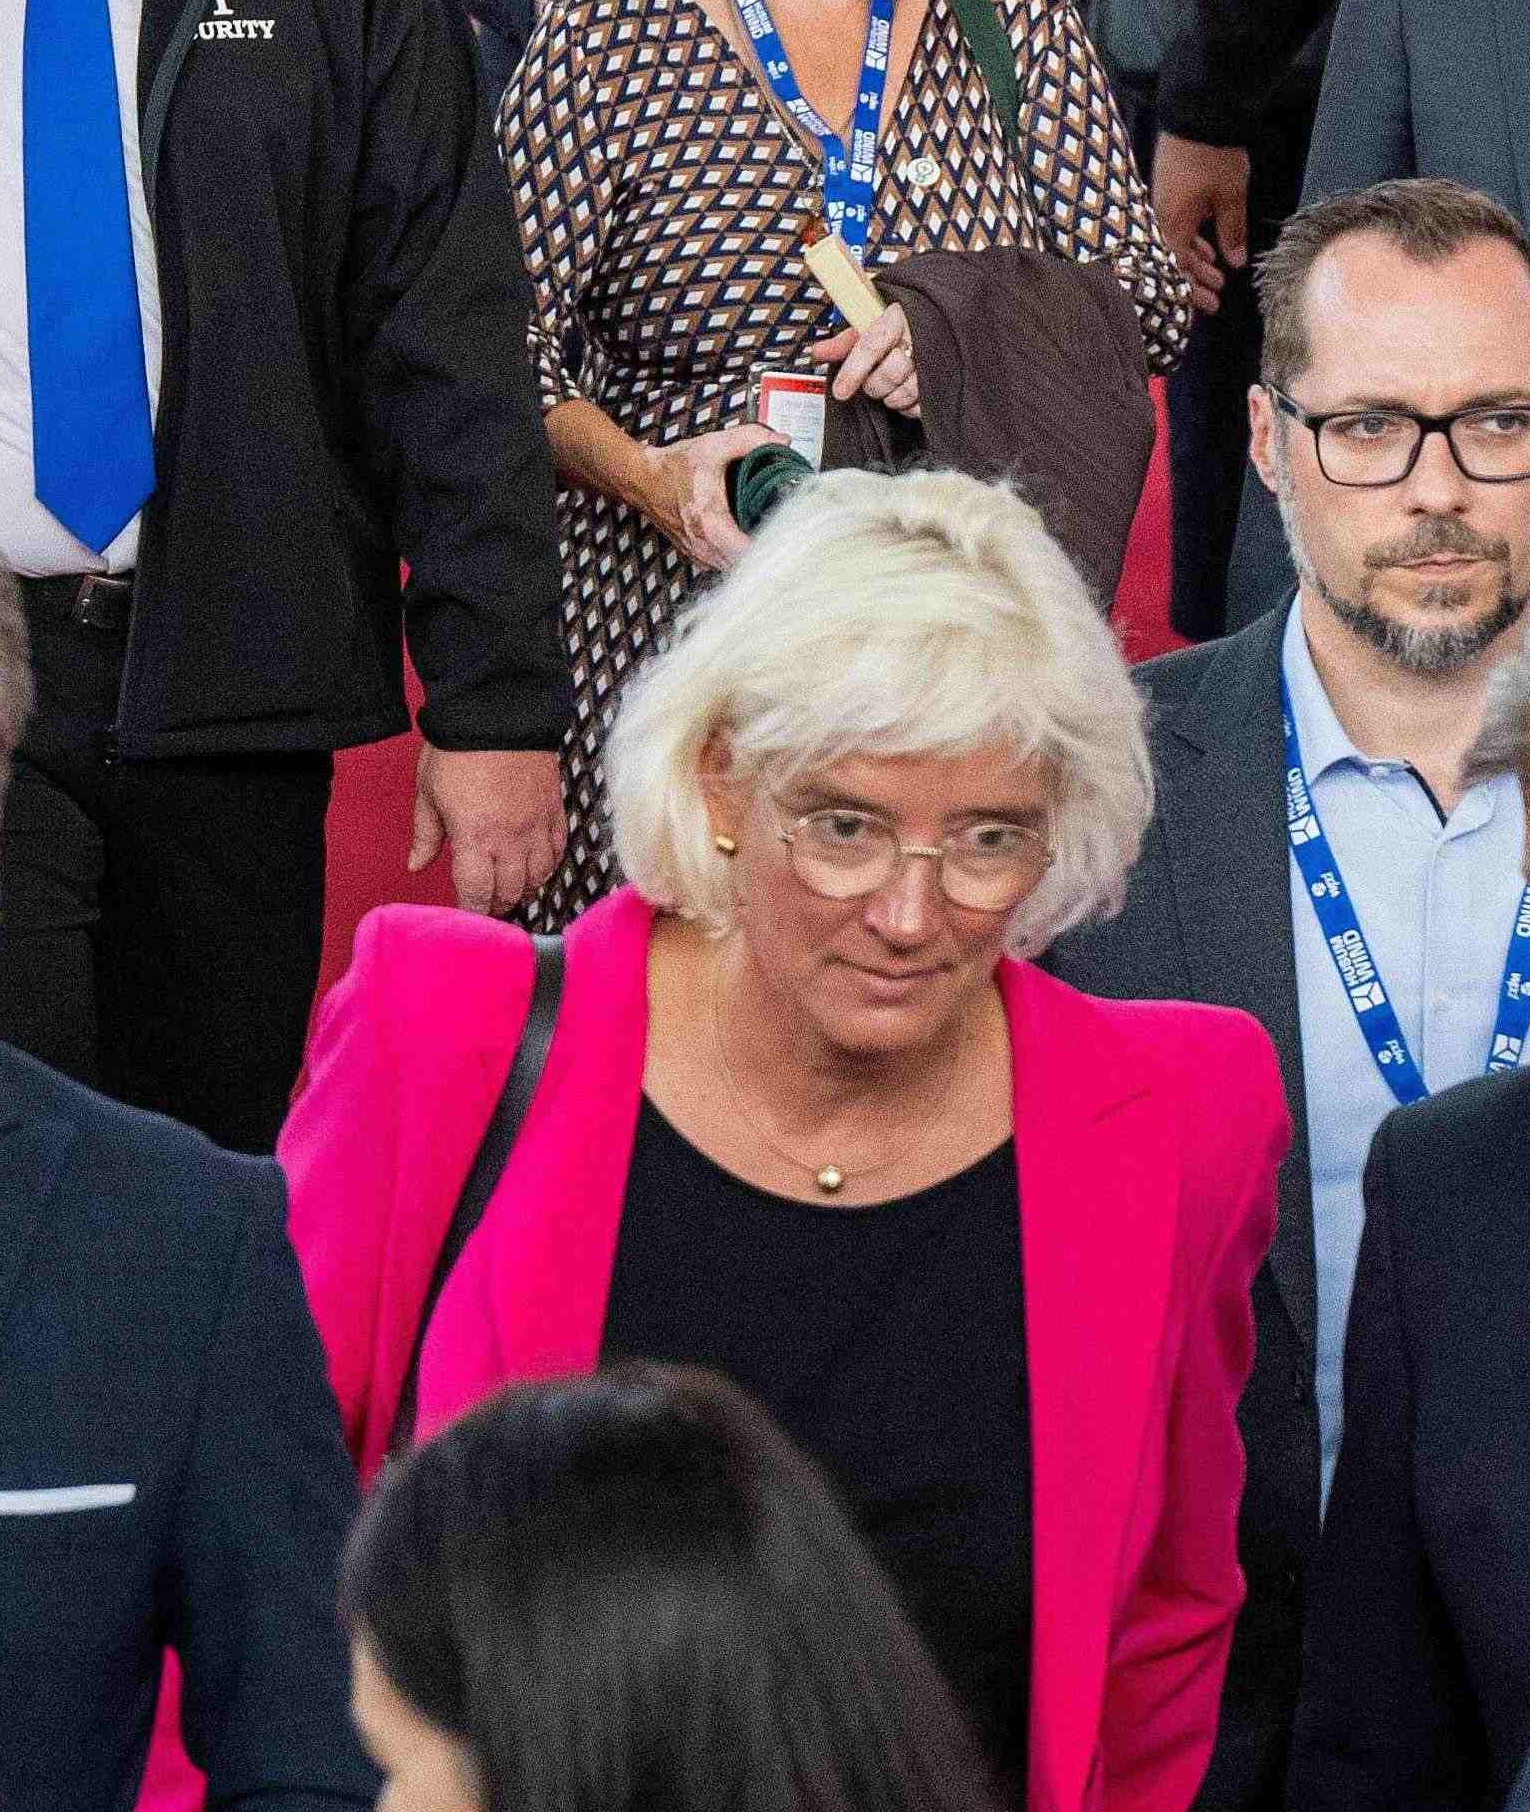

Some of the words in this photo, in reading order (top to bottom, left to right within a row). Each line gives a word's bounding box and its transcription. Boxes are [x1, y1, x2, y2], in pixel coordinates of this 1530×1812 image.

[193, 19, 276, 40] URITY
[1287, 766, 1312, 818] WIND
[1329, 934, 1360, 988] HUSUM
[1342, 929, 1375, 984] WIND
